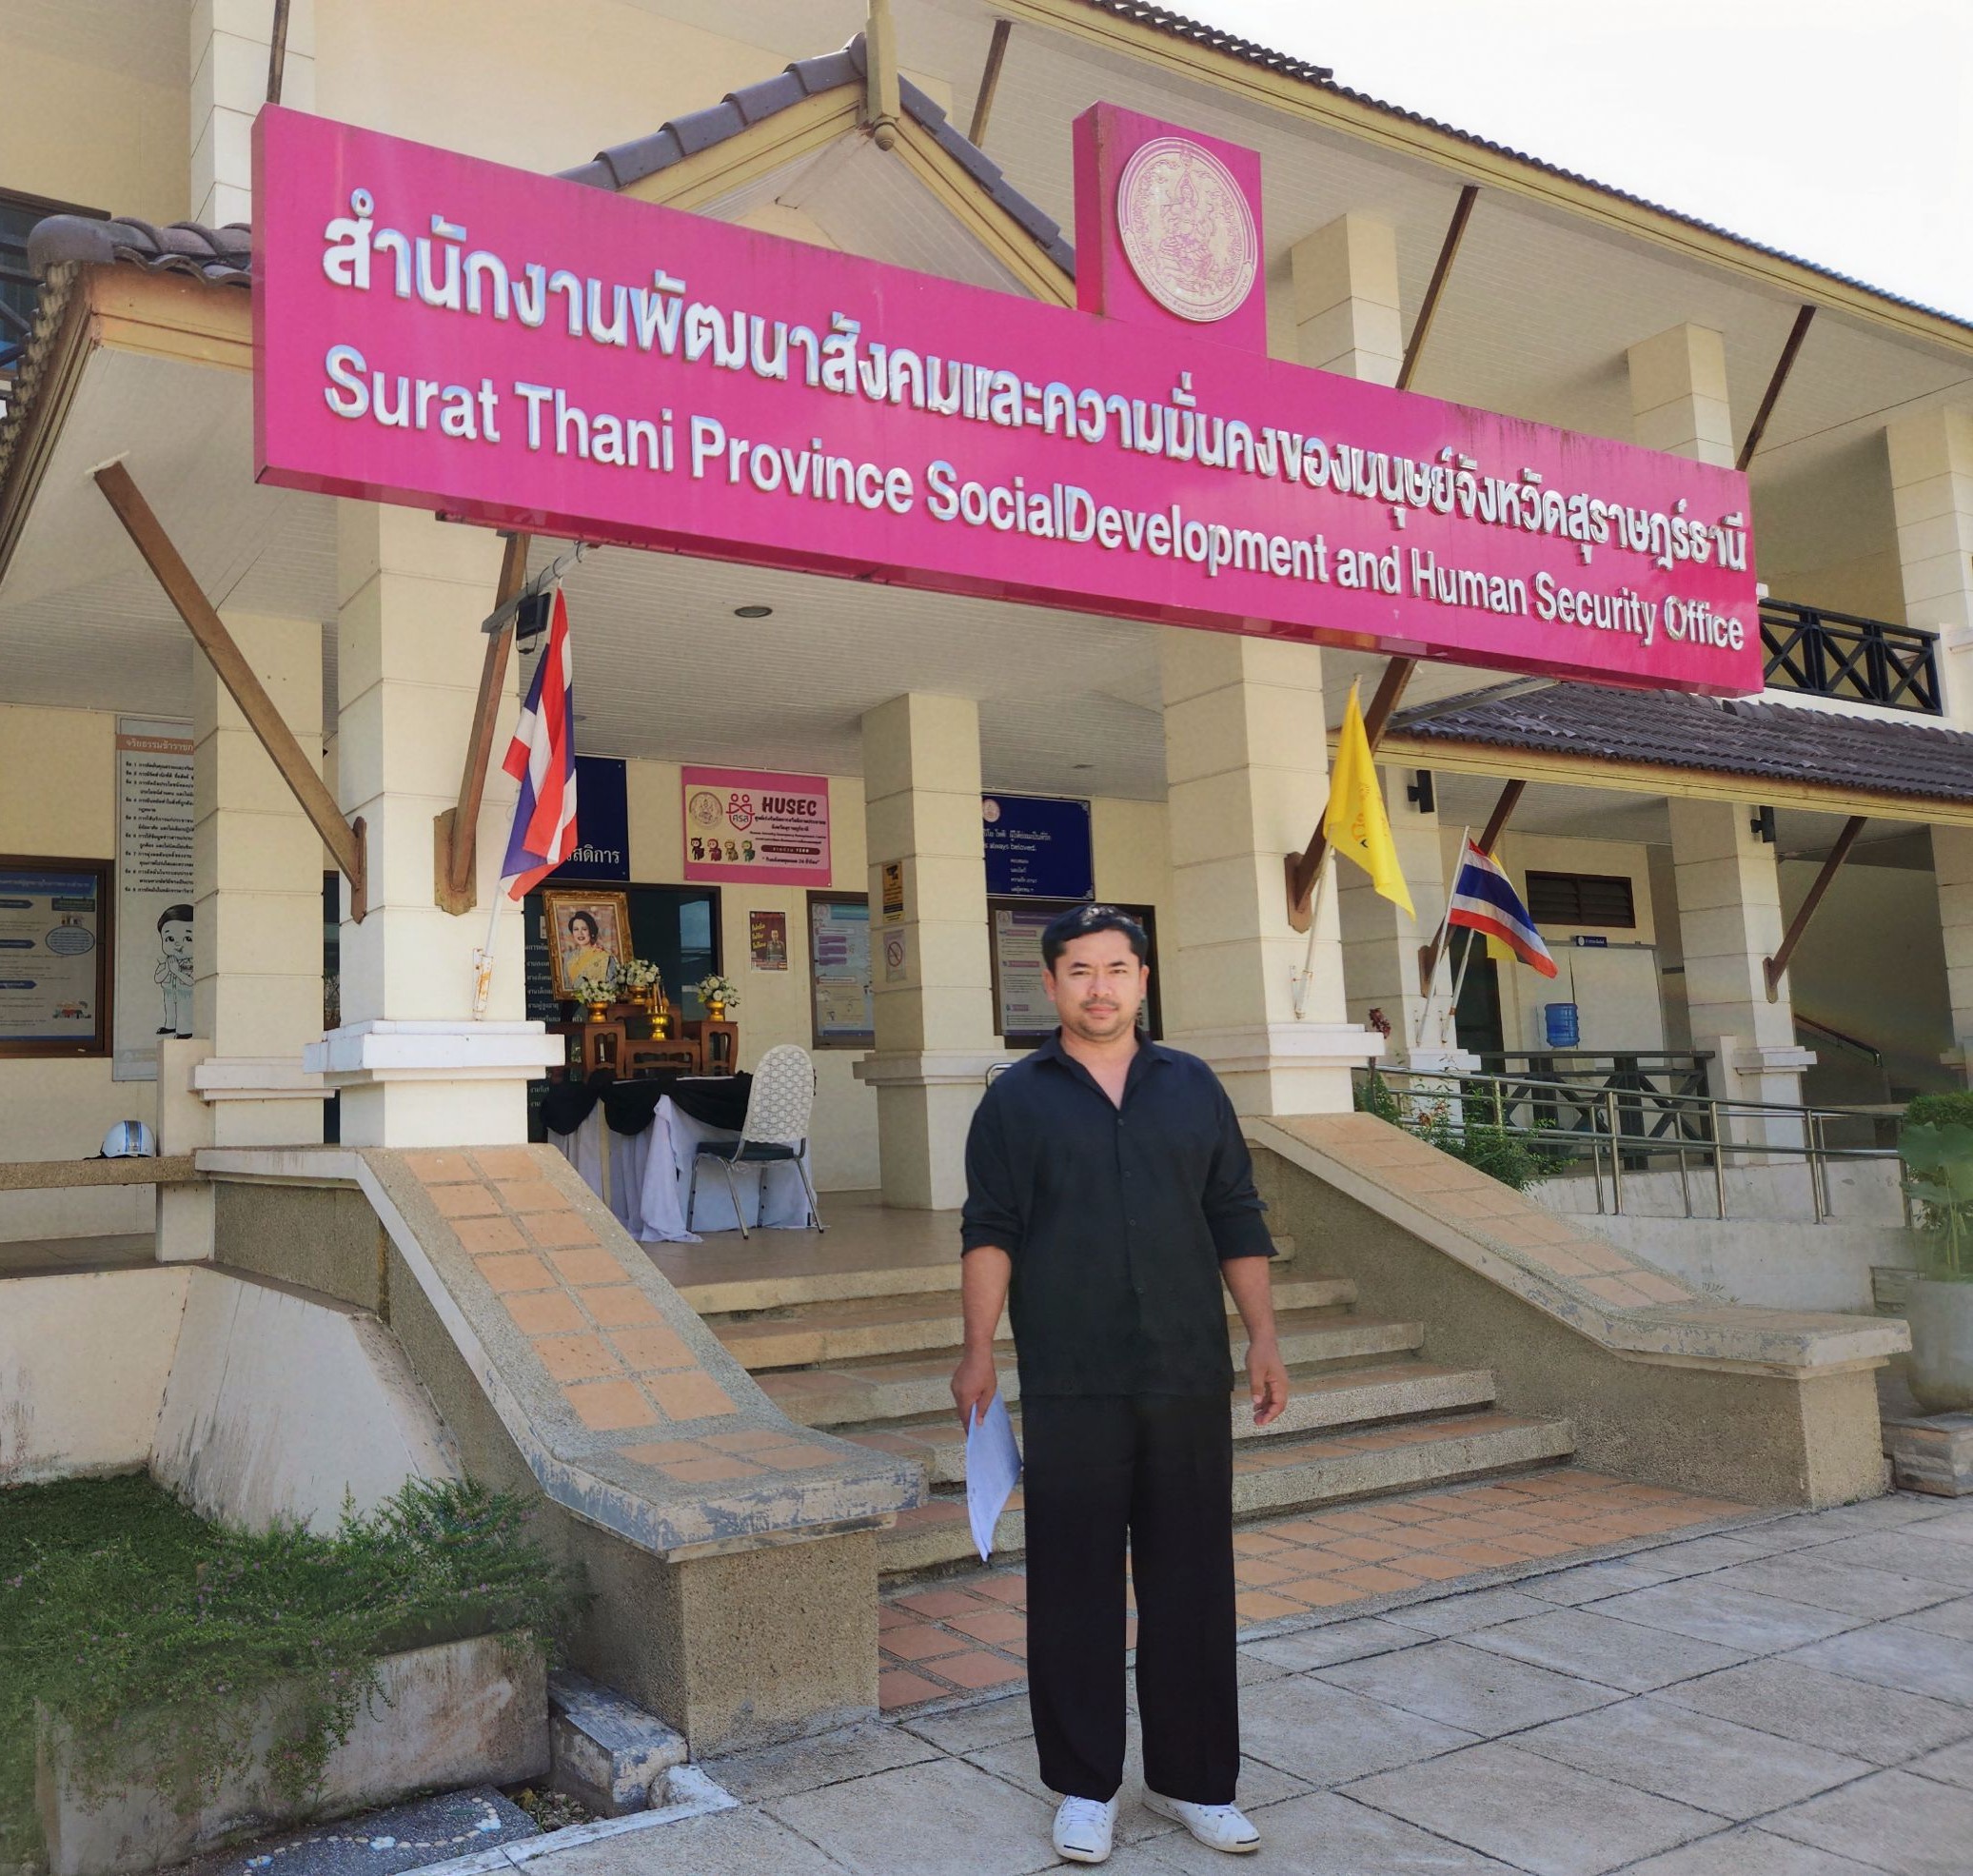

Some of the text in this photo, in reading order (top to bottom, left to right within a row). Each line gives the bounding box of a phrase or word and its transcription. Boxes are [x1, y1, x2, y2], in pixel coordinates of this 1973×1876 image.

[324, 345, 501, 443] Surat
[514, 382, 674, 472] Thani
[690, 415, 914, 514] Province
[1335, 545, 1401, 596] and
[1411, 547, 1528, 616] Human
[1534, 571, 1658, 647] Security
[1664, 595, 1746, 652] Office
[761, 797, 817, 817] HUSEC
